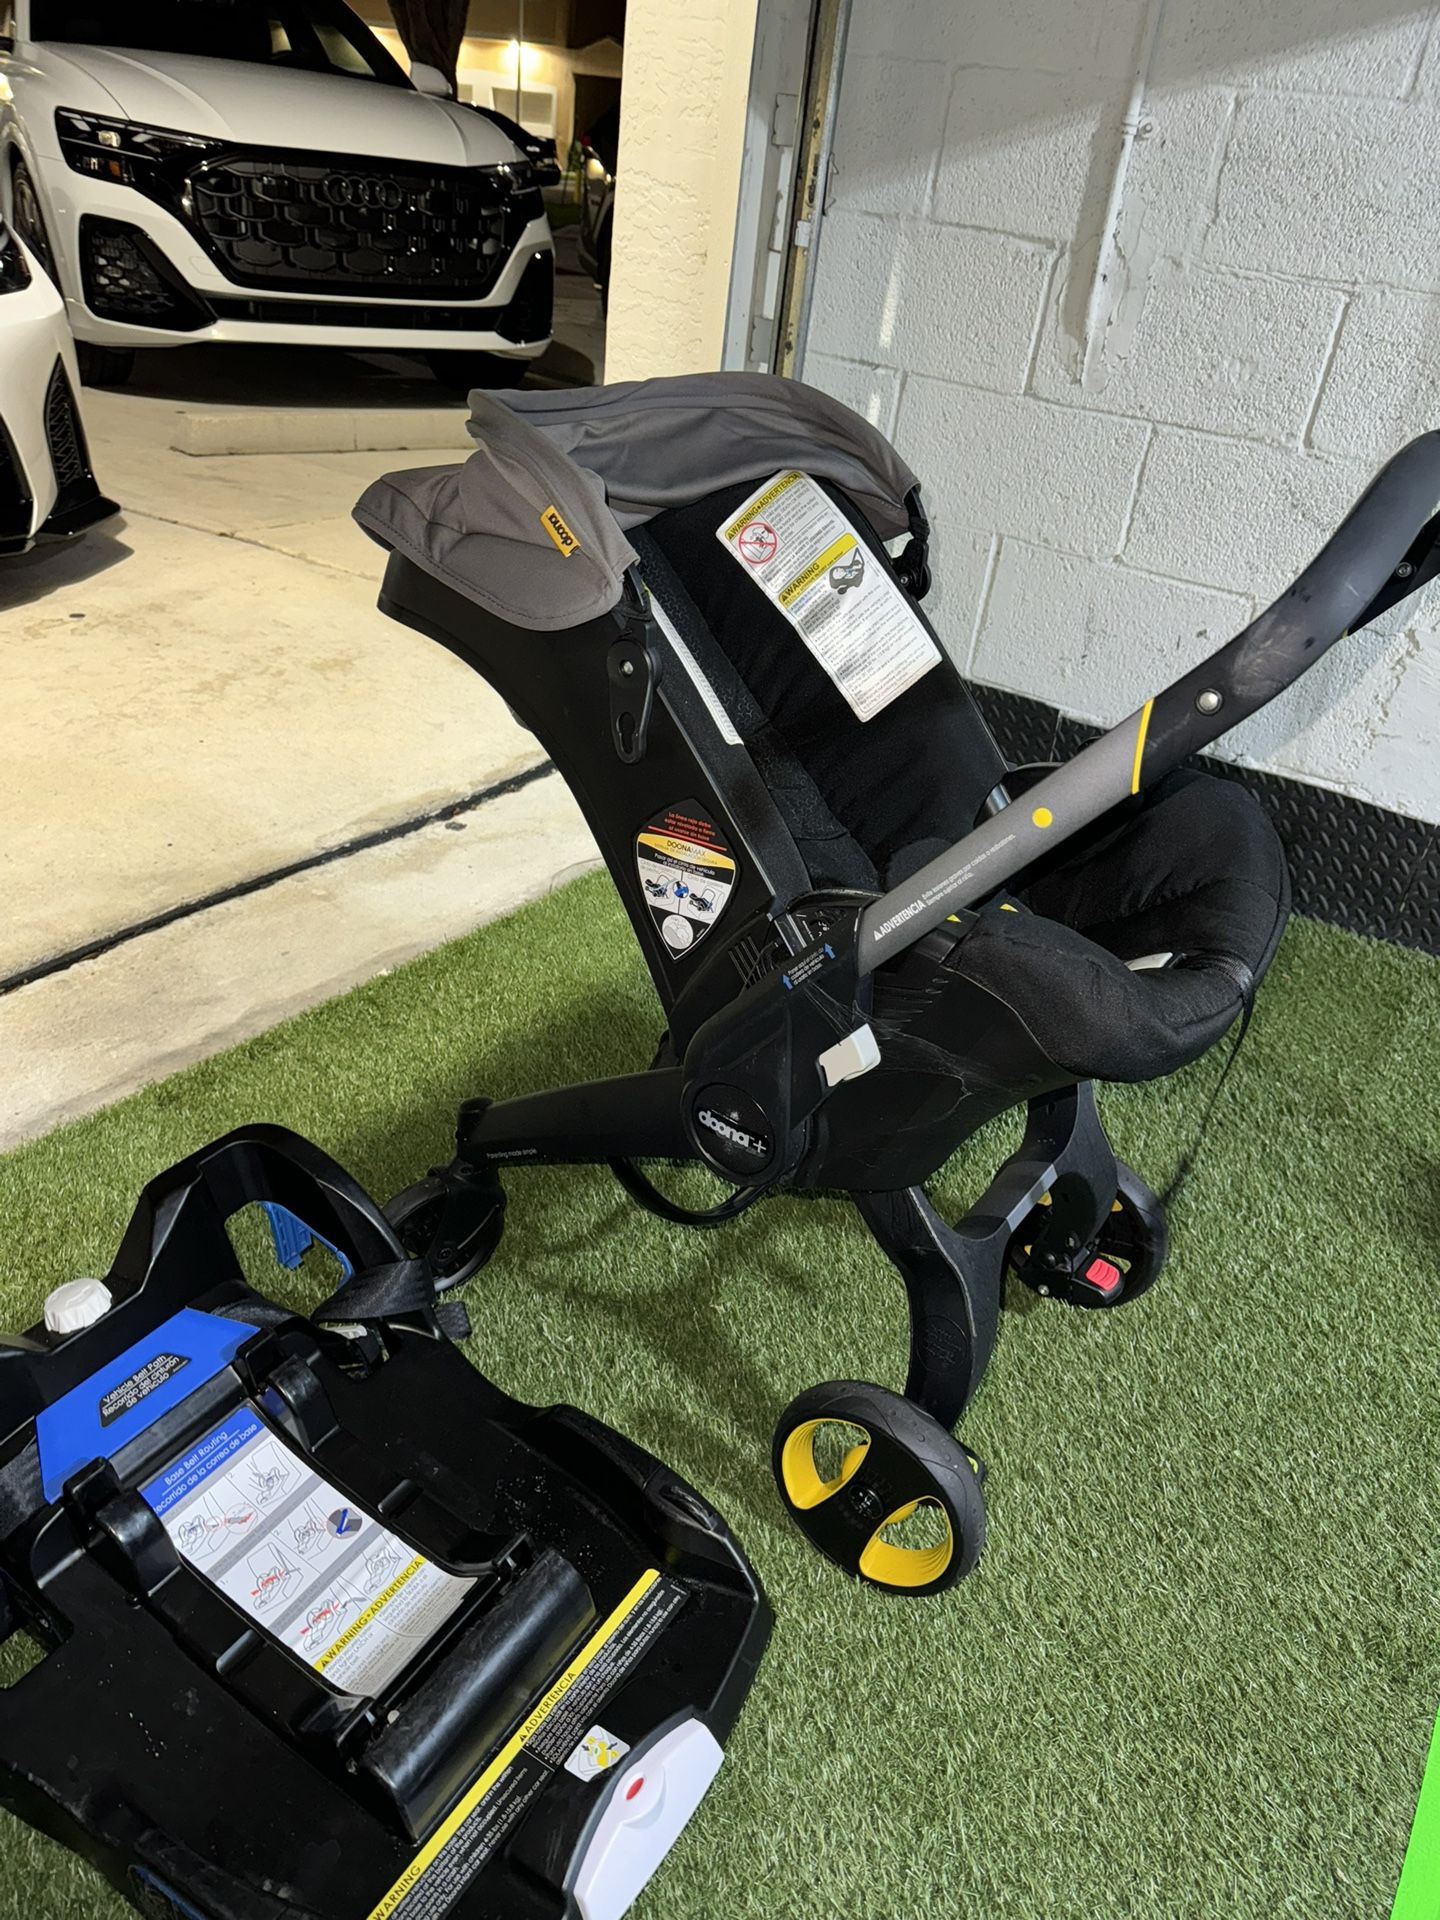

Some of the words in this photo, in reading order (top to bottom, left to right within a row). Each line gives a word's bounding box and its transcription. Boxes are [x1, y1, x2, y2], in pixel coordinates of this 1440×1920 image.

[548, 513, 573, 546] doona
[731, 507, 759, 534] WARNING
[785, 562, 820, 597] WARNING
[879, 899, 927, 936] ADVERTENCIA
[102, 1378, 134, 1404] Vehicle
[131, 1366, 149, 1382] Belt
[147, 1352, 168, 1371] Path
[102, 1388, 139, 1417] Recorrido
[137, 1376, 153, 1391] del
[150, 1355, 181, 1381] cinturón
[125, 1395, 139, 1408] de
[164, 1466, 186, 1486] Base
[183, 1454, 201, 1470] Belt
[198, 1430, 230, 1458] Routing
[185, 1473, 200, 1486] de
[197, 1465, 208, 1477] la
[204, 1445, 233, 1470] correa
[228, 1436, 242, 1449] de
[239, 1421, 260, 1441] base
[326, 1615, 369, 1661] WARNING
[369, 1558, 422, 1616] ADVERTENCIA
[523, 1669, 577, 1734] ADVERTENCIA
[372, 1863, 422, 1920] WARNING
